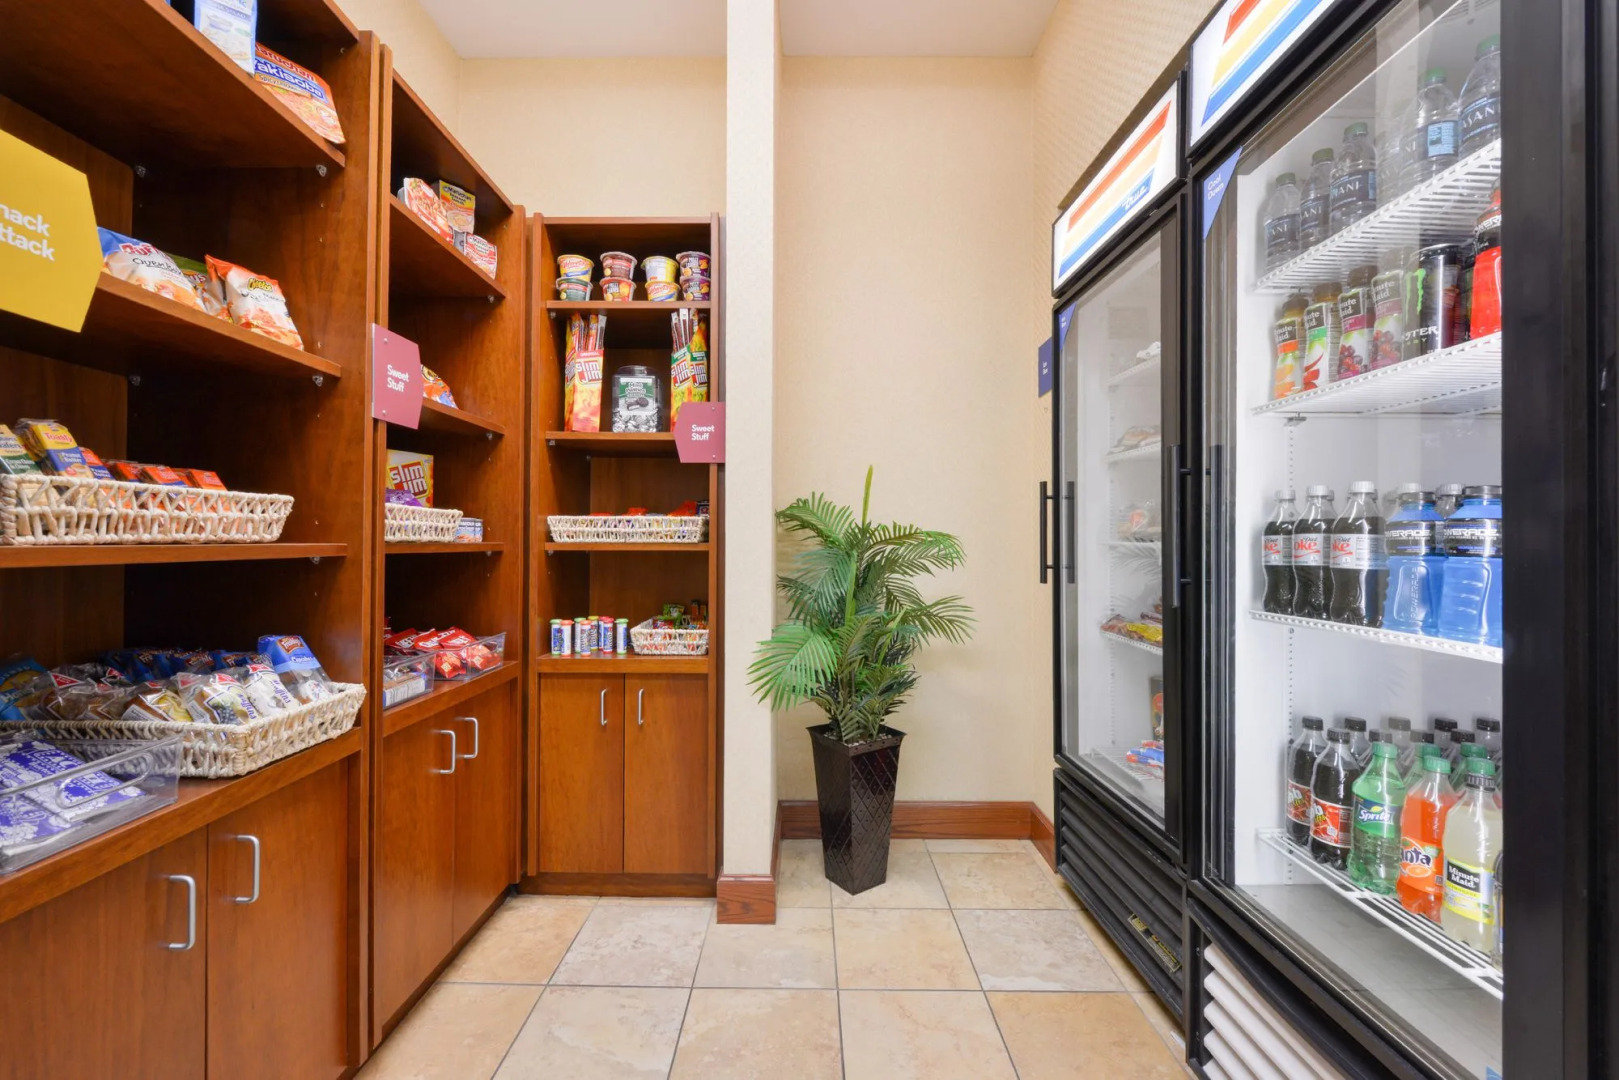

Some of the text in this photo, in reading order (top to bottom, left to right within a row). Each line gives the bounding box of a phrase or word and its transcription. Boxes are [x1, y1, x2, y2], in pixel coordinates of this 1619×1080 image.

[1208, 173, 1222, 190] Cool
[387, 364, 410, 382] Sweet
[387, 377, 405, 392] Stuff
[691, 424, 715, 432] Sweet
[691, 432, 710, 441] Stuff
[1359, 809, 1390, 822] Sprite
[1448, 865, 1480, 883] Minute
[1451, 873, 1475, 888] Maid
